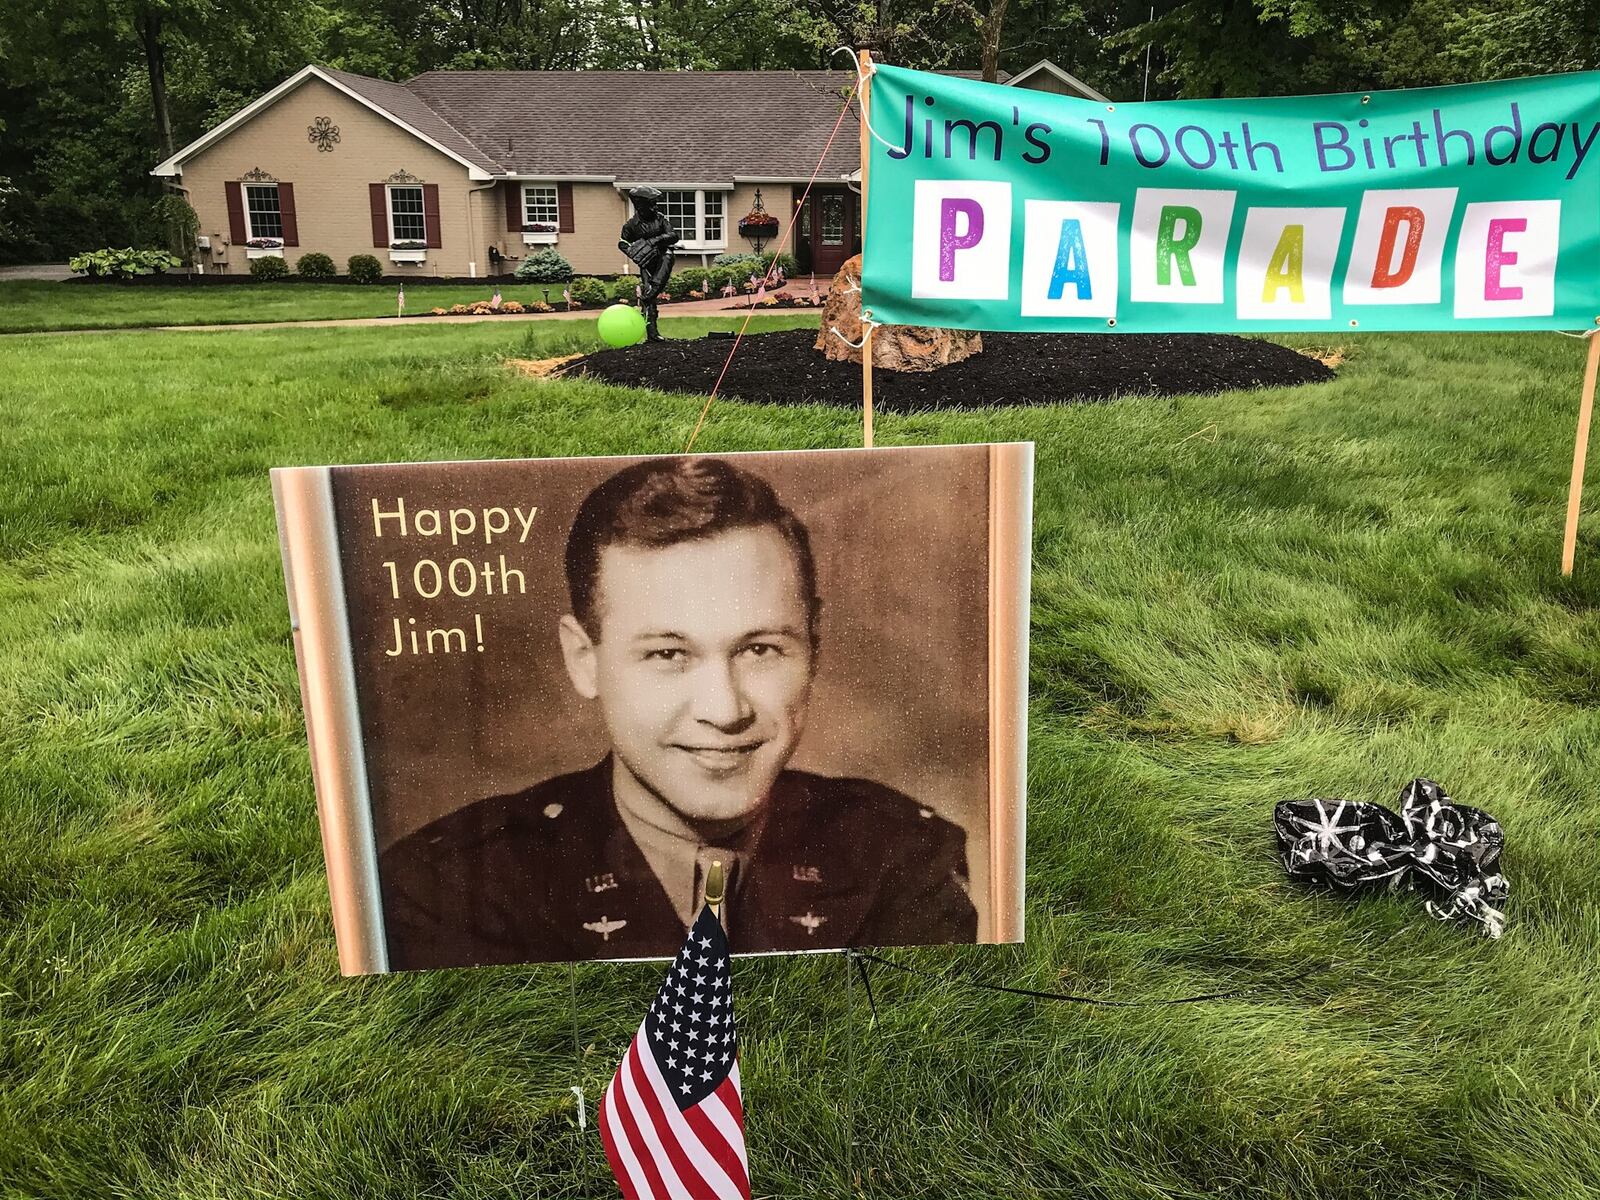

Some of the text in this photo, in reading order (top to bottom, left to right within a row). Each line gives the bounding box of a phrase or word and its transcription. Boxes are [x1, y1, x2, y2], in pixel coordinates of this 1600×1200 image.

[886, 94, 1600, 180] Jim's 100th Birthday
[938, 197, 1528, 303] PARADE
[371, 497, 538, 545] Happy
[382, 554, 526, 599] 100th
[385, 613, 485, 657] Jim!
